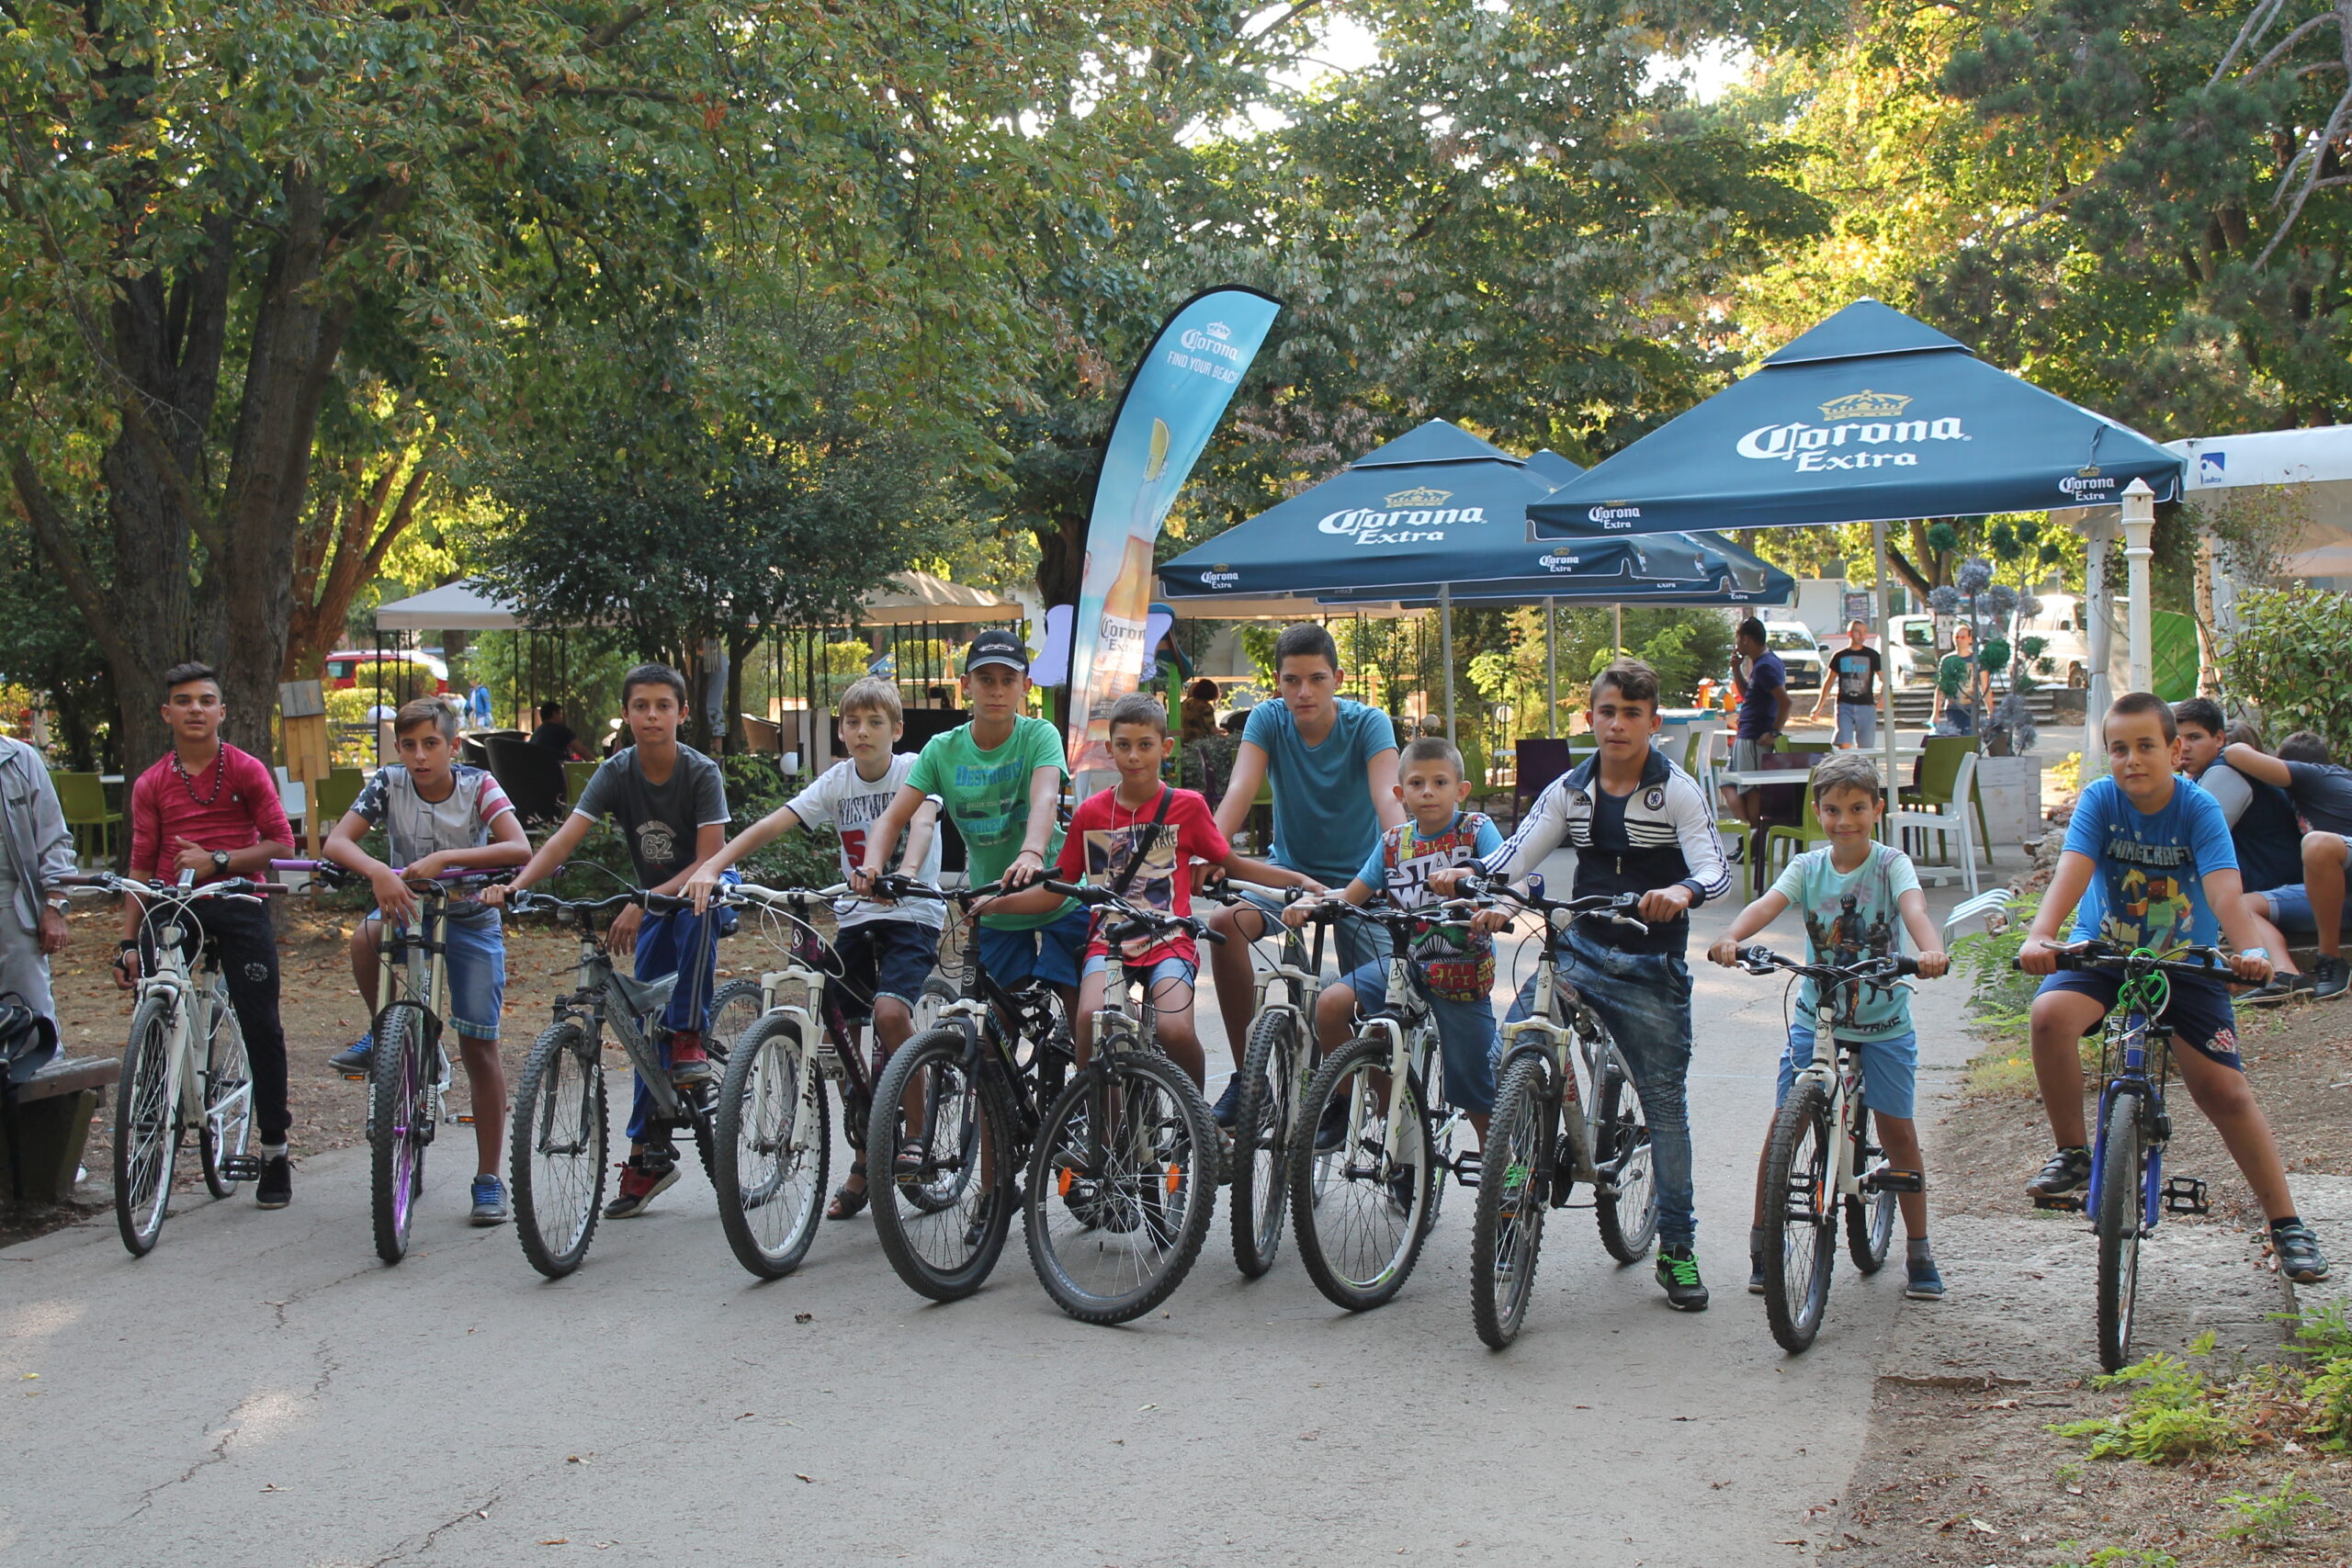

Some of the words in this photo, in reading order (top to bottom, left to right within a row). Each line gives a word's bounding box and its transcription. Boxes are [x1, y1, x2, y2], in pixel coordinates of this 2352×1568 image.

[1181, 328, 1239, 361] Corona
[1167, 351, 1188, 368] FIND
[1190, 357, 1213, 377] YOUR
[1212, 364, 1240, 384] BEACH
[1736, 417, 1965, 461] Corona
[1794, 450, 1918, 473] Extra
[2058, 476, 2115, 495] Corona
[2075, 491, 2105, 502] Extra
[1317, 507, 1485, 536] Corona
[1588, 506, 1641, 523] Corona
[1603, 520, 1632, 530] Extra
[1354, 528, 1444, 546] Extra
[1538, 555, 1579, 568] Corona
[1550, 564, 1572, 573] Extra
[1200, 570, 1239, 584] Corona
[1212, 581, 1232, 589] Extra
[1101, 616, 1147, 640] Coron
[640, 833, 673, 860] 62
[2107, 838, 2194, 866] MINECRAFT
[1388, 845, 1471, 886] STAR
[425, 1084, 437, 1121] ROCKSHOX
